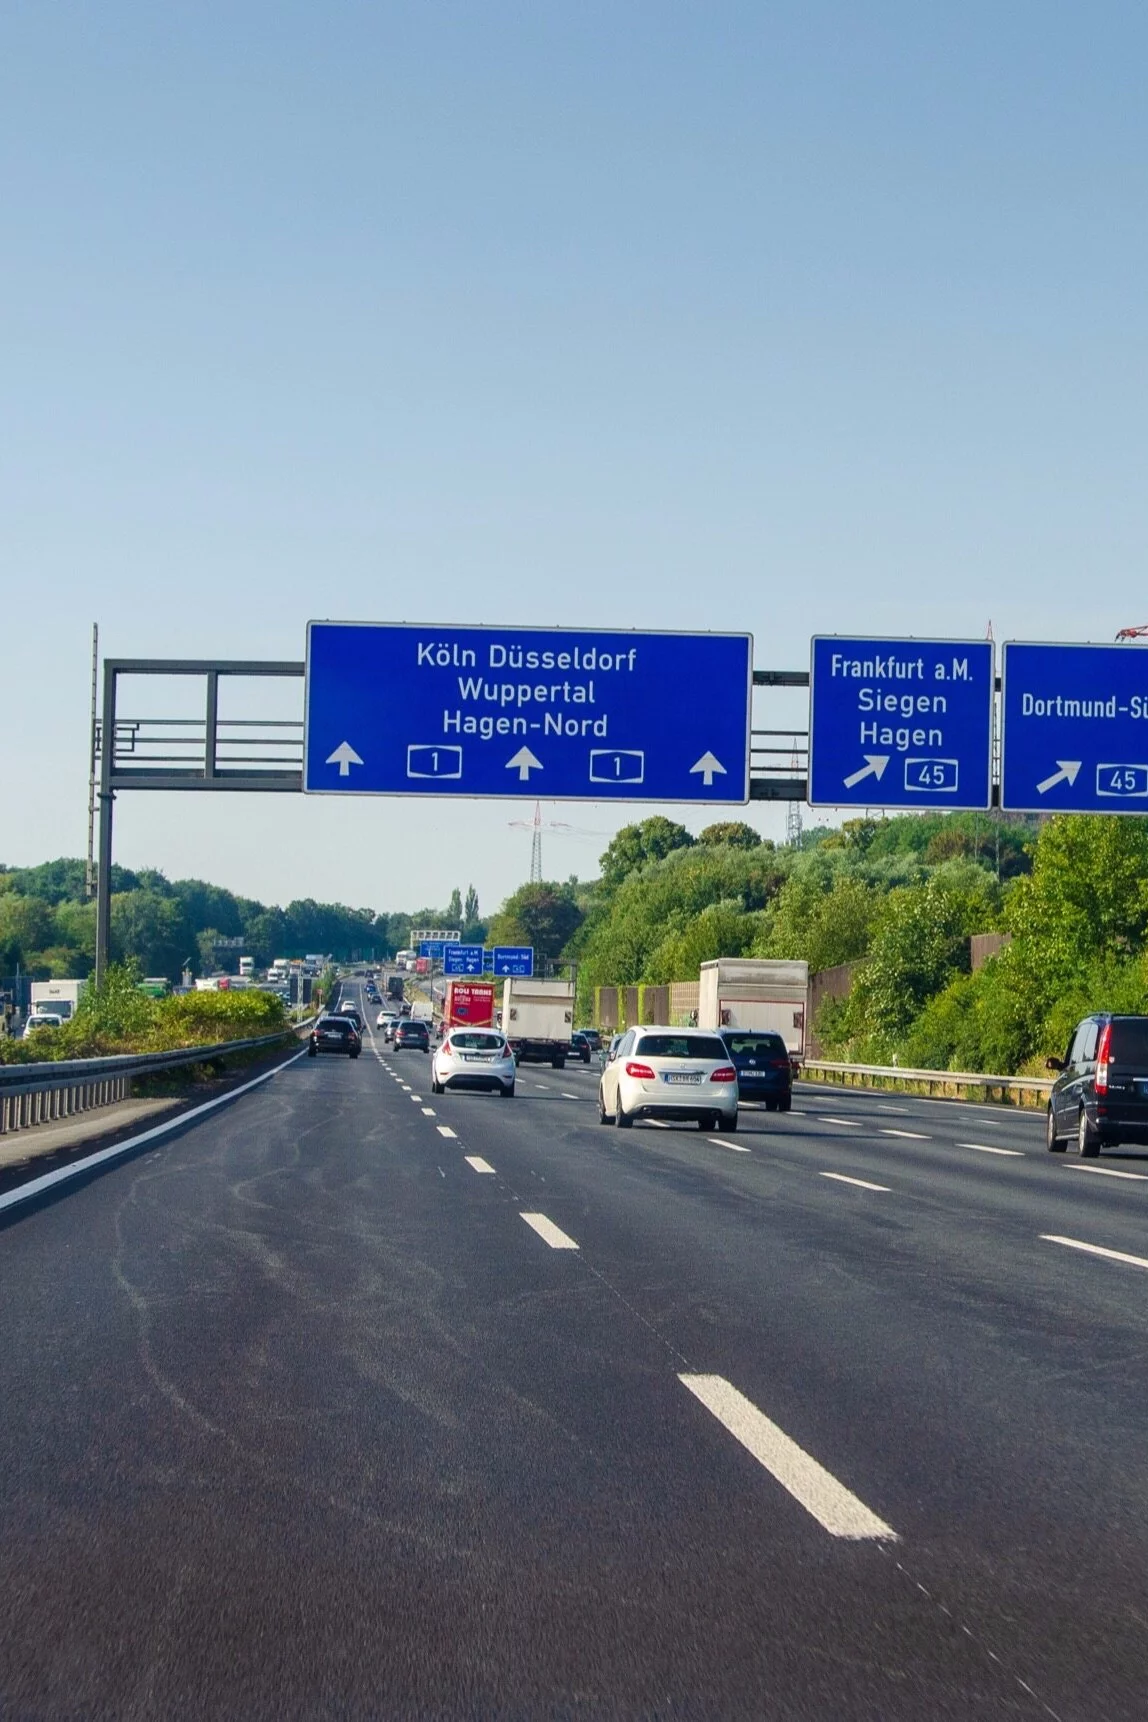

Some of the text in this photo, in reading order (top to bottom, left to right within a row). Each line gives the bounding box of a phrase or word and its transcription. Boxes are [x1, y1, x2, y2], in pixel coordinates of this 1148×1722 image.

[418, 643, 636, 670] Köln Düsseldorf
[832, 655, 972, 680] Frankfurt a.M.
[459, 678, 594, 706] Wuppertal
[859, 689, 946, 717] Siegen
[444, 711, 606, 739] Hagen-Nord
[861, 722, 941, 750] Hagen
[431, 752, 439, 771] 1
[613, 757, 621, 776] 1
[919, 766, 943, 784] 45
[1111, 772, 1135, 789] 45
